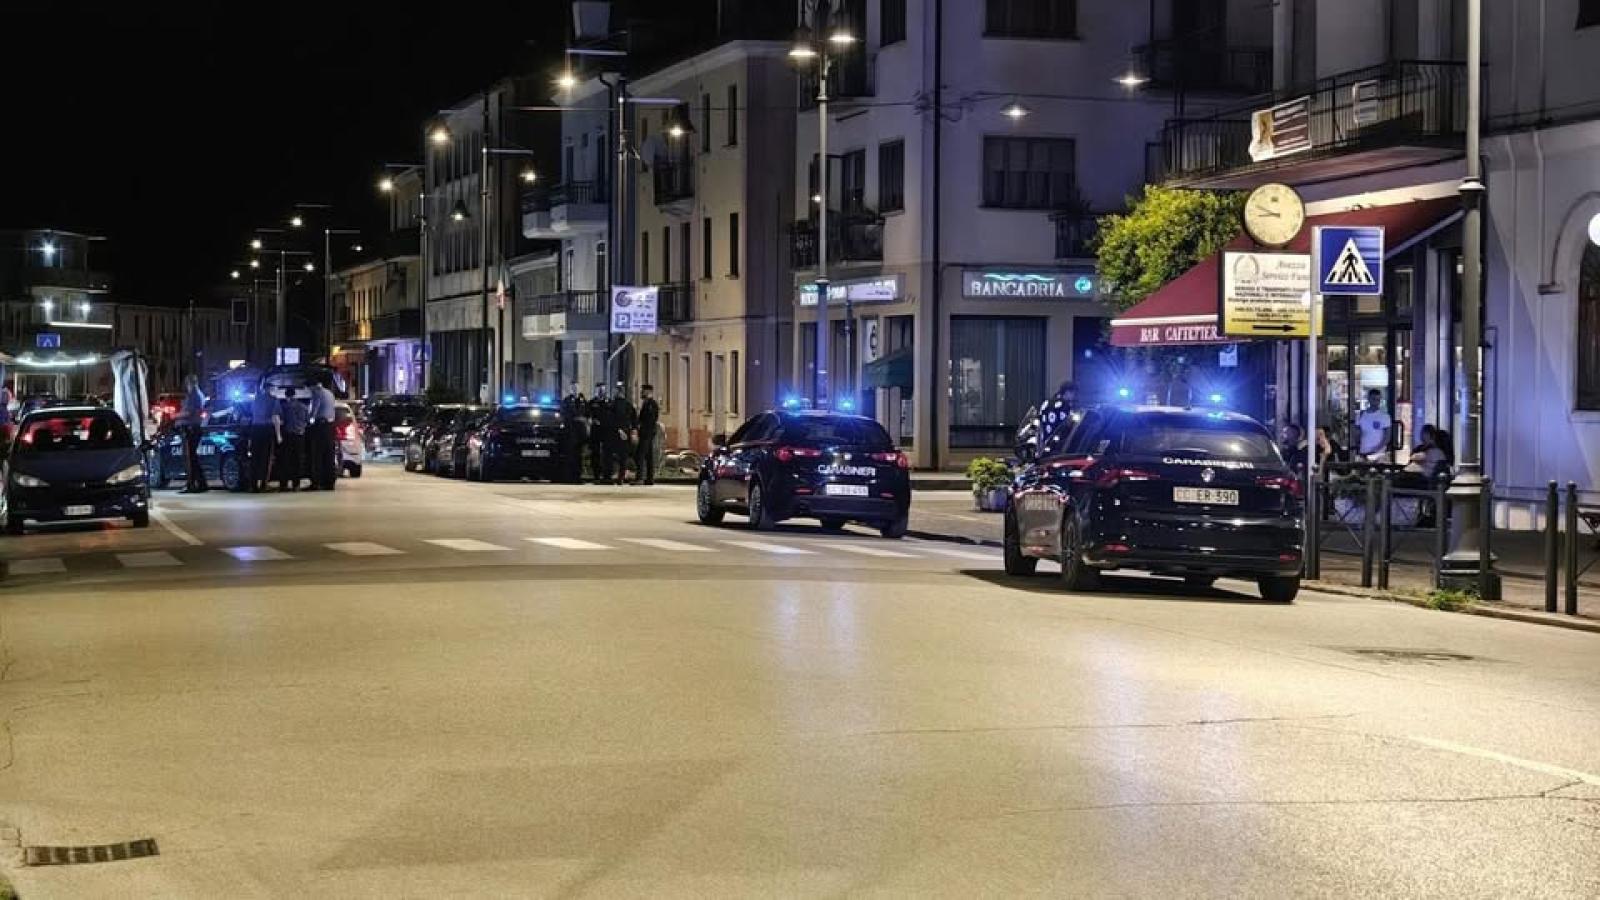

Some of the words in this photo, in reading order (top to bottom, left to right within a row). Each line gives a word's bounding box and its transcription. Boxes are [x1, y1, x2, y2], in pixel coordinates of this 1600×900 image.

[971, 281, 1064, 296] BANCADRIA
[1141, 327, 1160, 342] BAR
[1162, 457, 1254, 469] CARABINIERI
[817, 464, 876, 478] CARABINIERI
